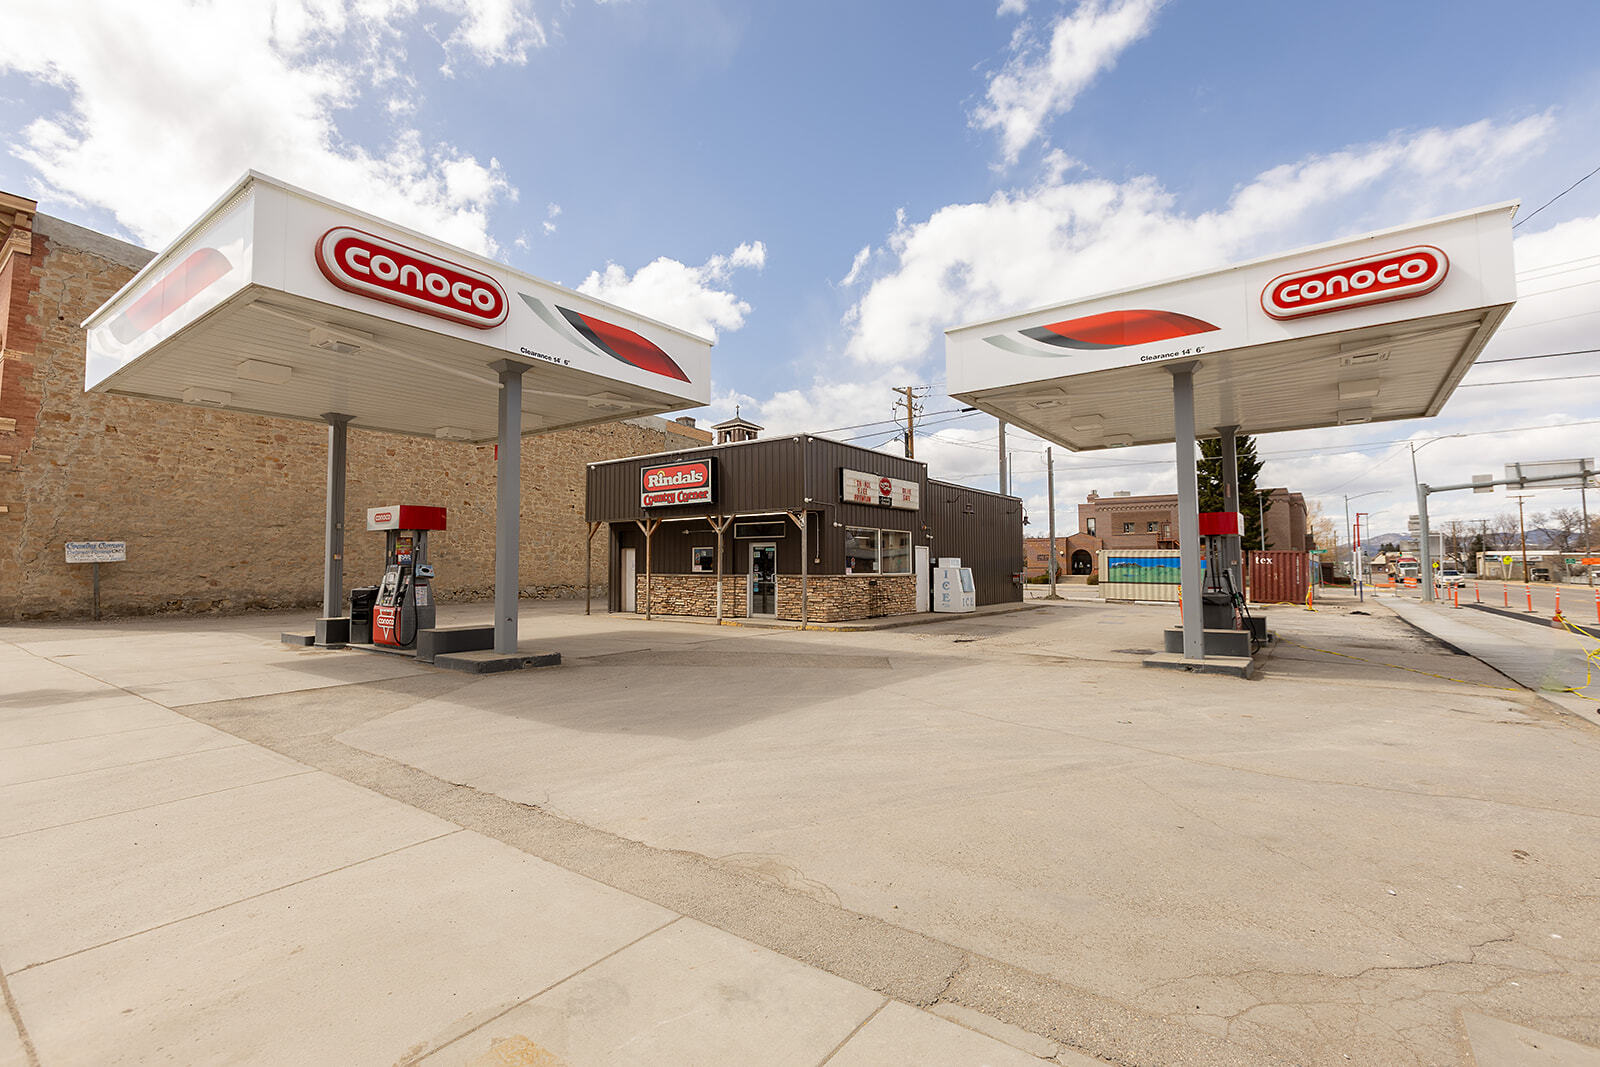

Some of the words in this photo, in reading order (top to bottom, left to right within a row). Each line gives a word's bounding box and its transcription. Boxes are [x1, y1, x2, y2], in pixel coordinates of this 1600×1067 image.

[520, 346, 552, 361] Clearance
[1140, 351, 1180, 362] Clearance
[648, 470, 703, 488] Rindals
[643, 493, 676, 506] Country
[677, 490, 709, 503] Corner
